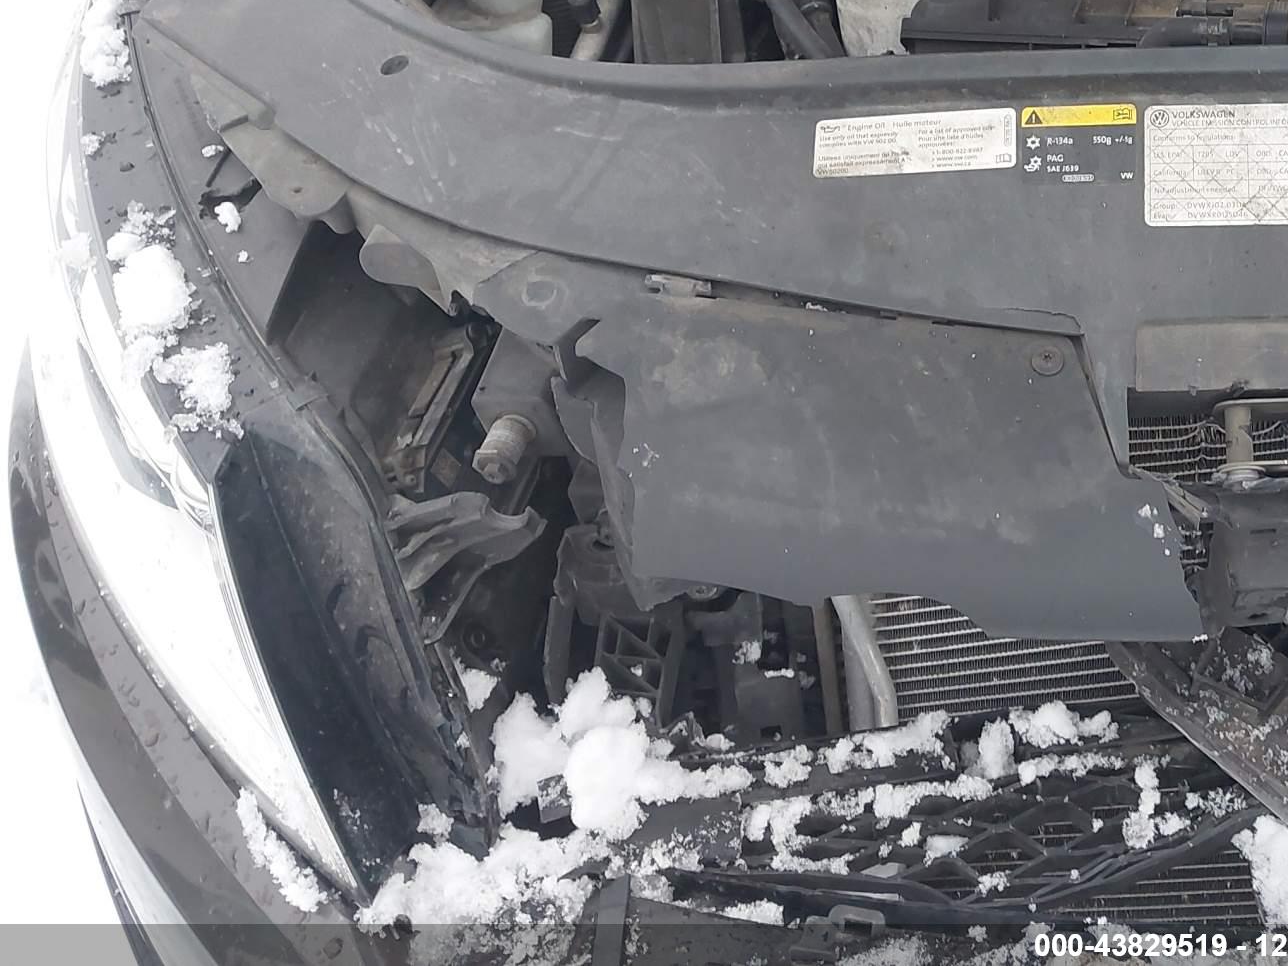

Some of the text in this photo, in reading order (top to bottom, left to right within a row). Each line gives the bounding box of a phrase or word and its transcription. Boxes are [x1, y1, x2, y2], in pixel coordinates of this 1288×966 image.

[1171, 109, 1236, 119] VOLKSWAGEN
[847, 119, 942, 133] Engine Oil Huile moteur
[1171, 119, 1199, 127] VEHICLE
[1236, 118, 1269, 126] CONTROL
[1046, 137, 1074, 146] R-134a
[1092, 135, 1112, 145] 550g
[1278, 149, 1288, 157] CA
[1046, 154, 1064, 163] PAG
[1046, 165, 1060, 173] SAE
[1120, 172, 1134, 180] VW
